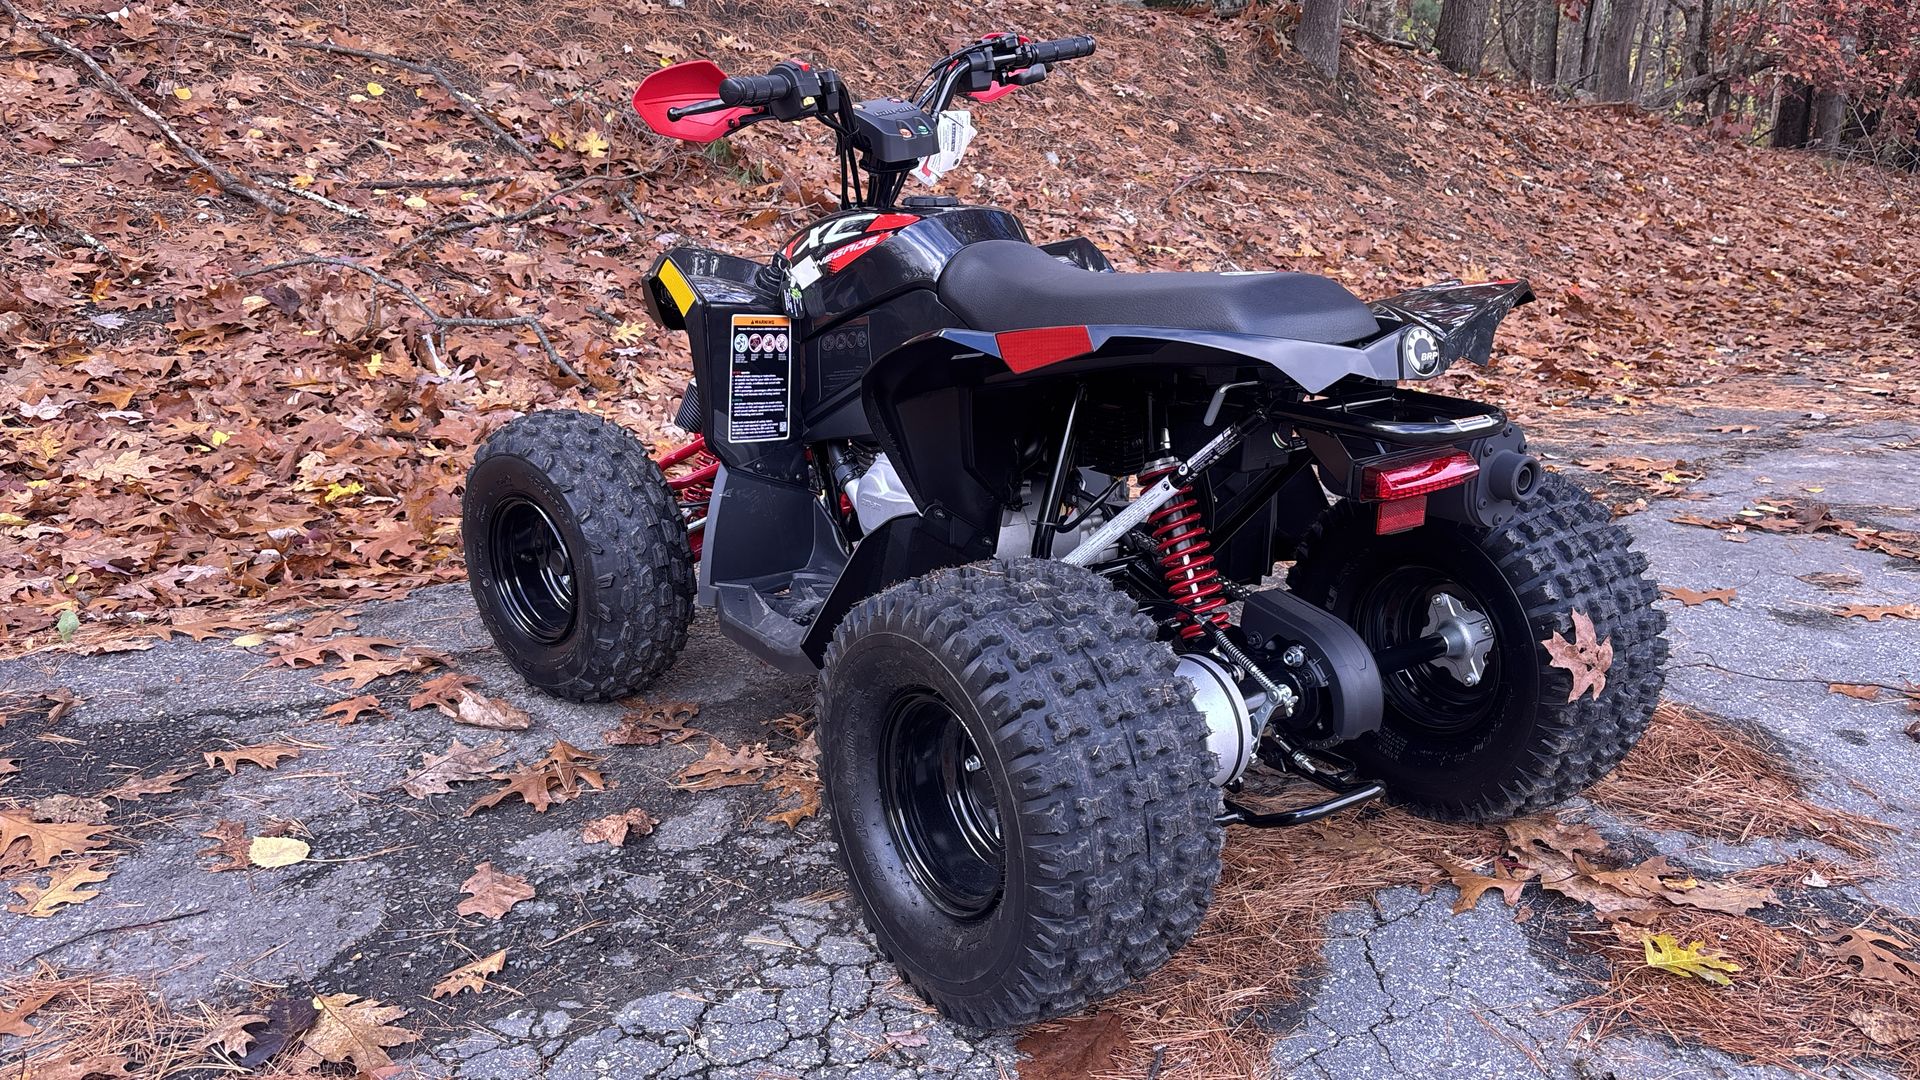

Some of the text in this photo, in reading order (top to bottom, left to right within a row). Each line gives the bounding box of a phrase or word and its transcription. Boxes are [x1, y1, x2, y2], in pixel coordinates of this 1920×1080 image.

[793, 213, 880, 257] XC
[815, 235, 880, 266] NEGADE
[1420, 351, 1439, 362] BRP
